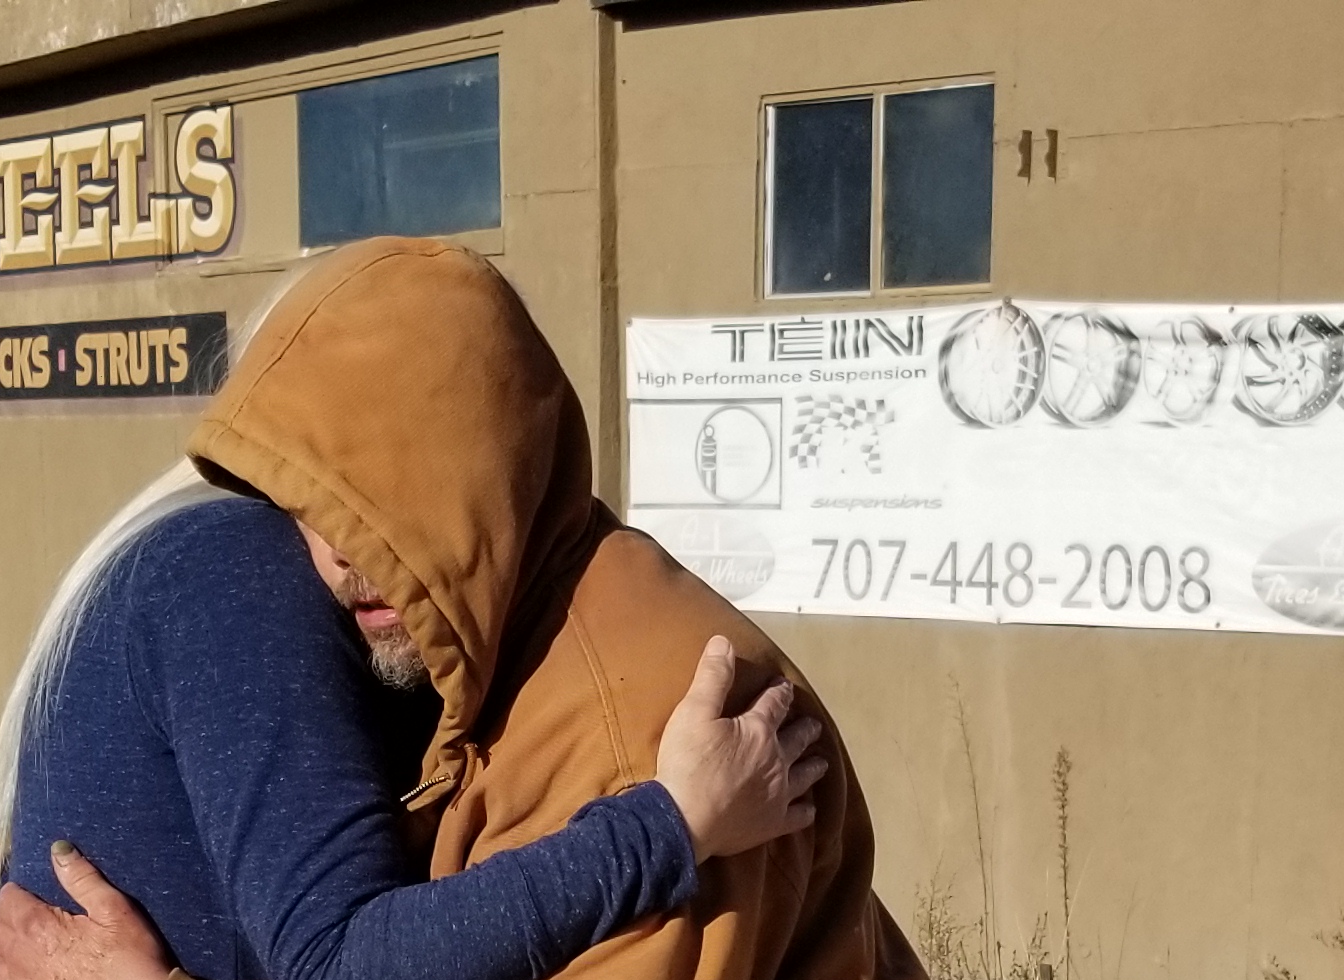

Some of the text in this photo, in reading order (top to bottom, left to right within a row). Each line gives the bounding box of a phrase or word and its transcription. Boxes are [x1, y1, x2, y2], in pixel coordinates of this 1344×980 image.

[74, 327, 190, 387] STRUTS
[710, 315, 925, 363] TEIN
[636, 366, 927, 388] High Performance Suspension
[809, 494, 943, 512] suspensions
[708, 557, 769, 585] Wheels
[810, 537, 1212, 614] 707-448-2008
